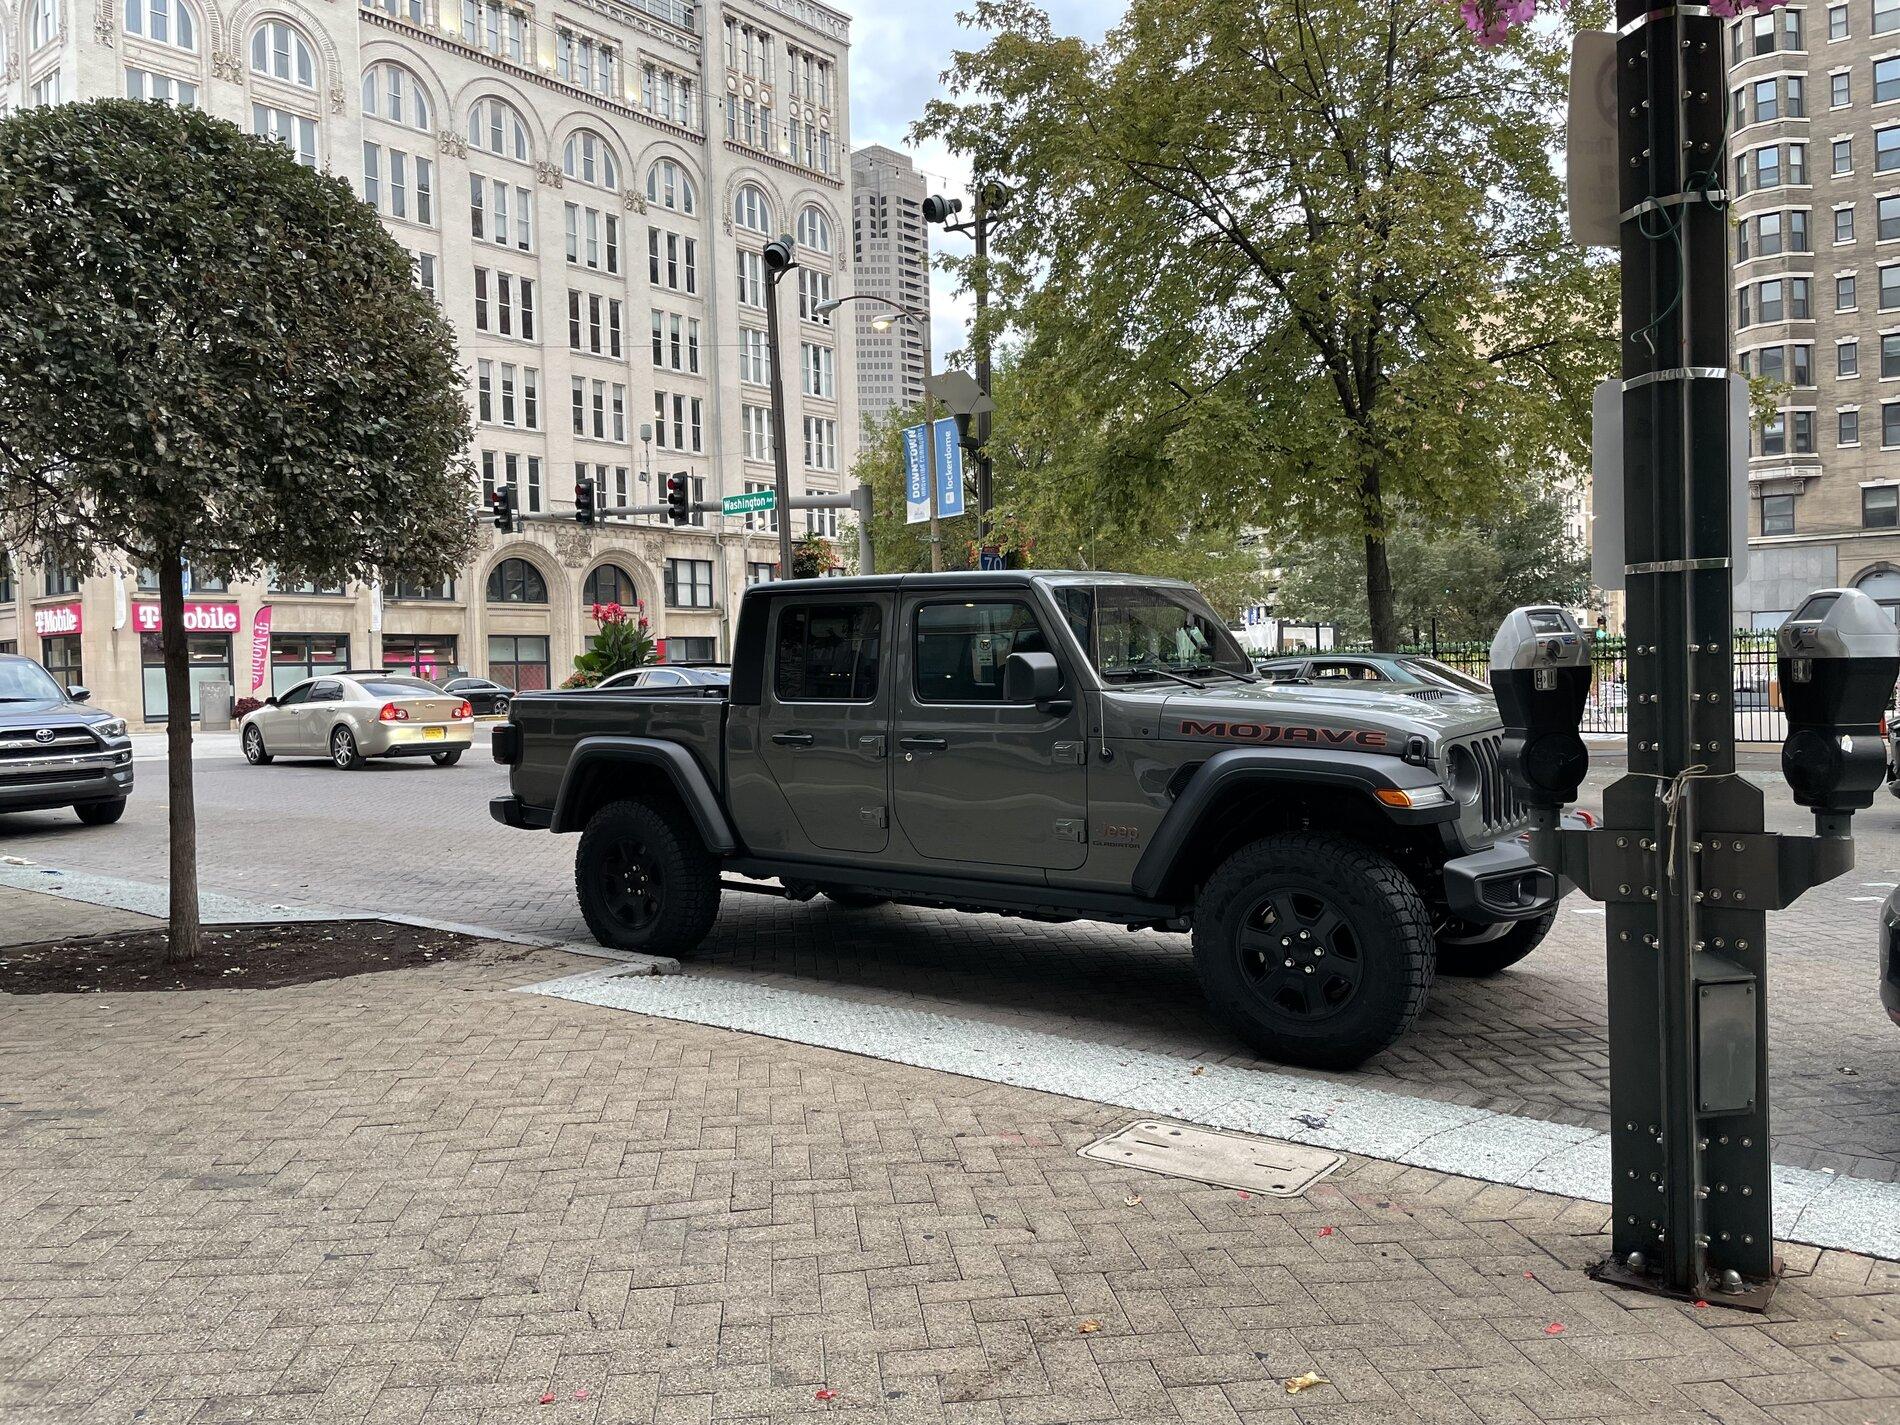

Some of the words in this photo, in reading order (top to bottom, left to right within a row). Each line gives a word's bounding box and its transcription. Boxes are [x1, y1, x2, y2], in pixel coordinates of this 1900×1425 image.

[908, 429, 920, 498] DOWNTOWN
[944, 431, 954, 489] lockerdome
[724, 496, 766, 511] Washington
[984, 557, 1003, 571] 70
[183, 604, 237, 630] obile
[1180, 720, 1389, 747] MOJAVE
[1101, 823, 1140, 842] Jeep
[1092, 840, 1141, 849] GLADIATOR
